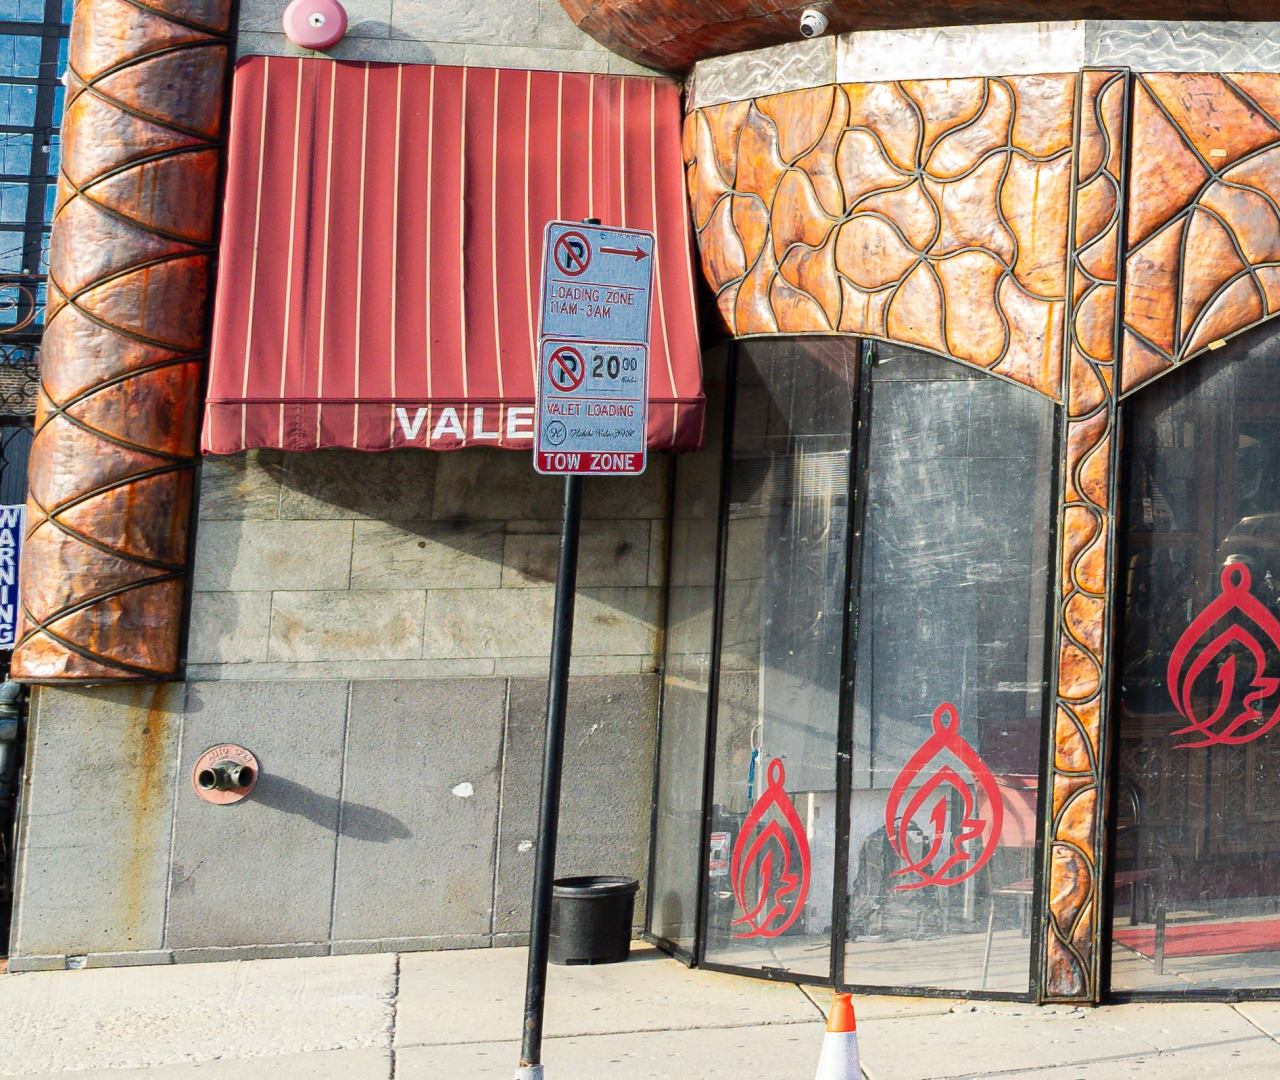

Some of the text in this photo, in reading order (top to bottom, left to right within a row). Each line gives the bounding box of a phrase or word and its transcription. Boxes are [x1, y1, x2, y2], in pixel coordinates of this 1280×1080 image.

[550, 286, 635, 306] LOADING ZONE
[592, 354, 620, 379] 20
[546, 402, 634, 417] VALET LOADING
[395, 407, 534, 440] VALE
[543, 453, 635, 470] TOW ZONE
[0, 508, 18, 645] WARNING
